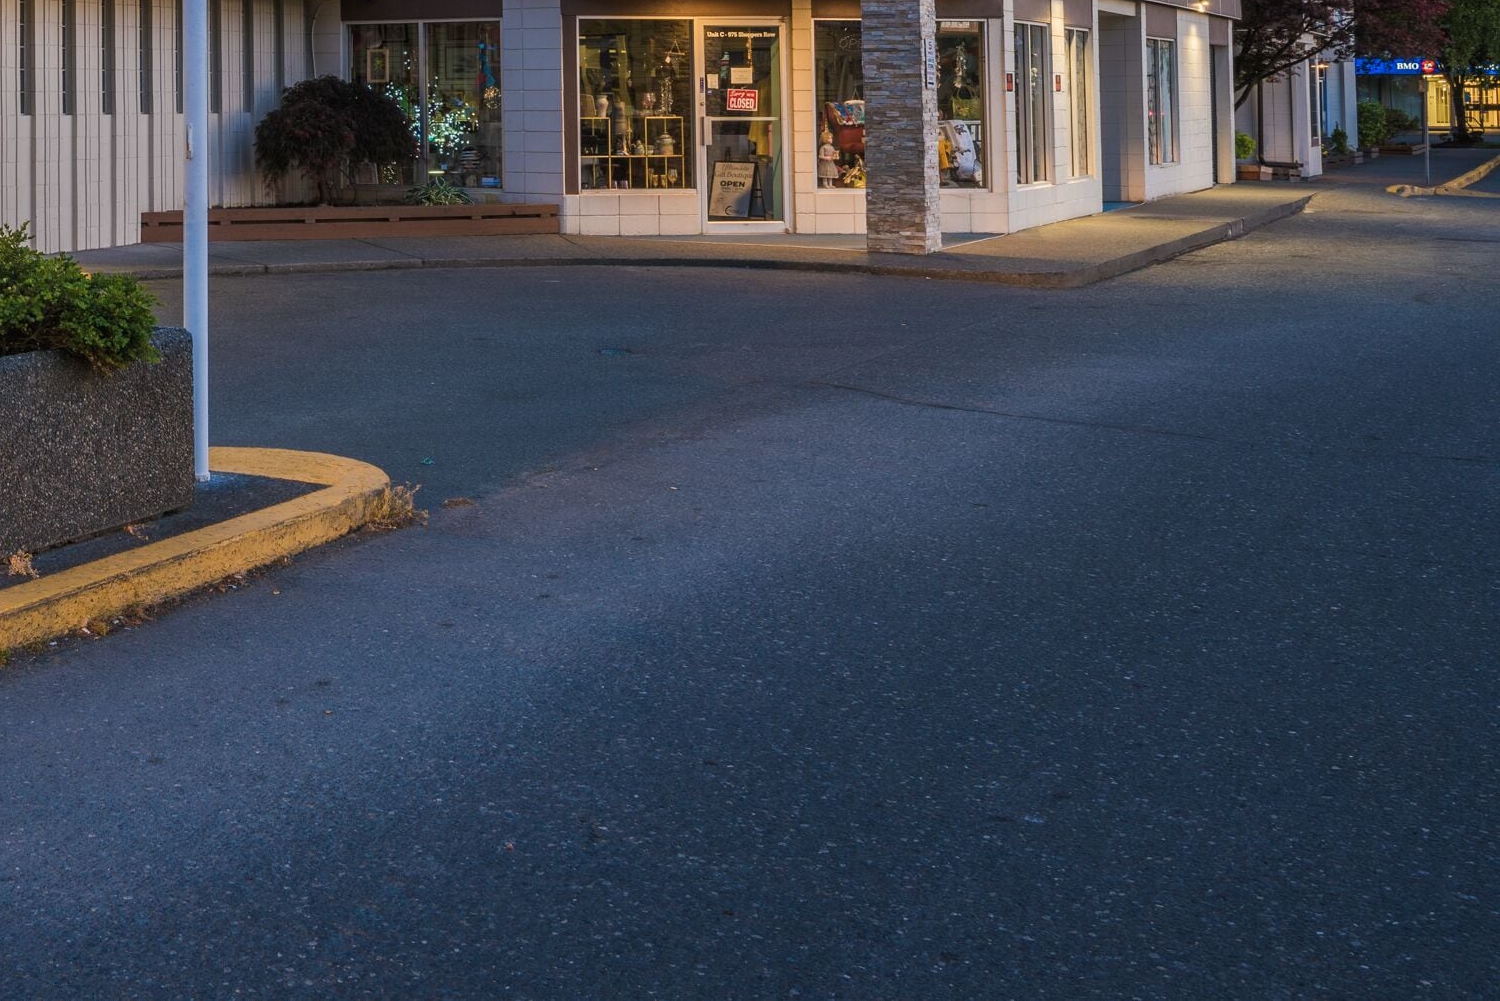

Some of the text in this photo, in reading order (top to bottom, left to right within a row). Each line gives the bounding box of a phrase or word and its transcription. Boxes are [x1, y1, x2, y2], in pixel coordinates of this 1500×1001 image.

[739, 31, 763, 39] Shoppers
[1396, 62, 1420, 70] BMO
[729, 97, 755, 109] CLOSED
